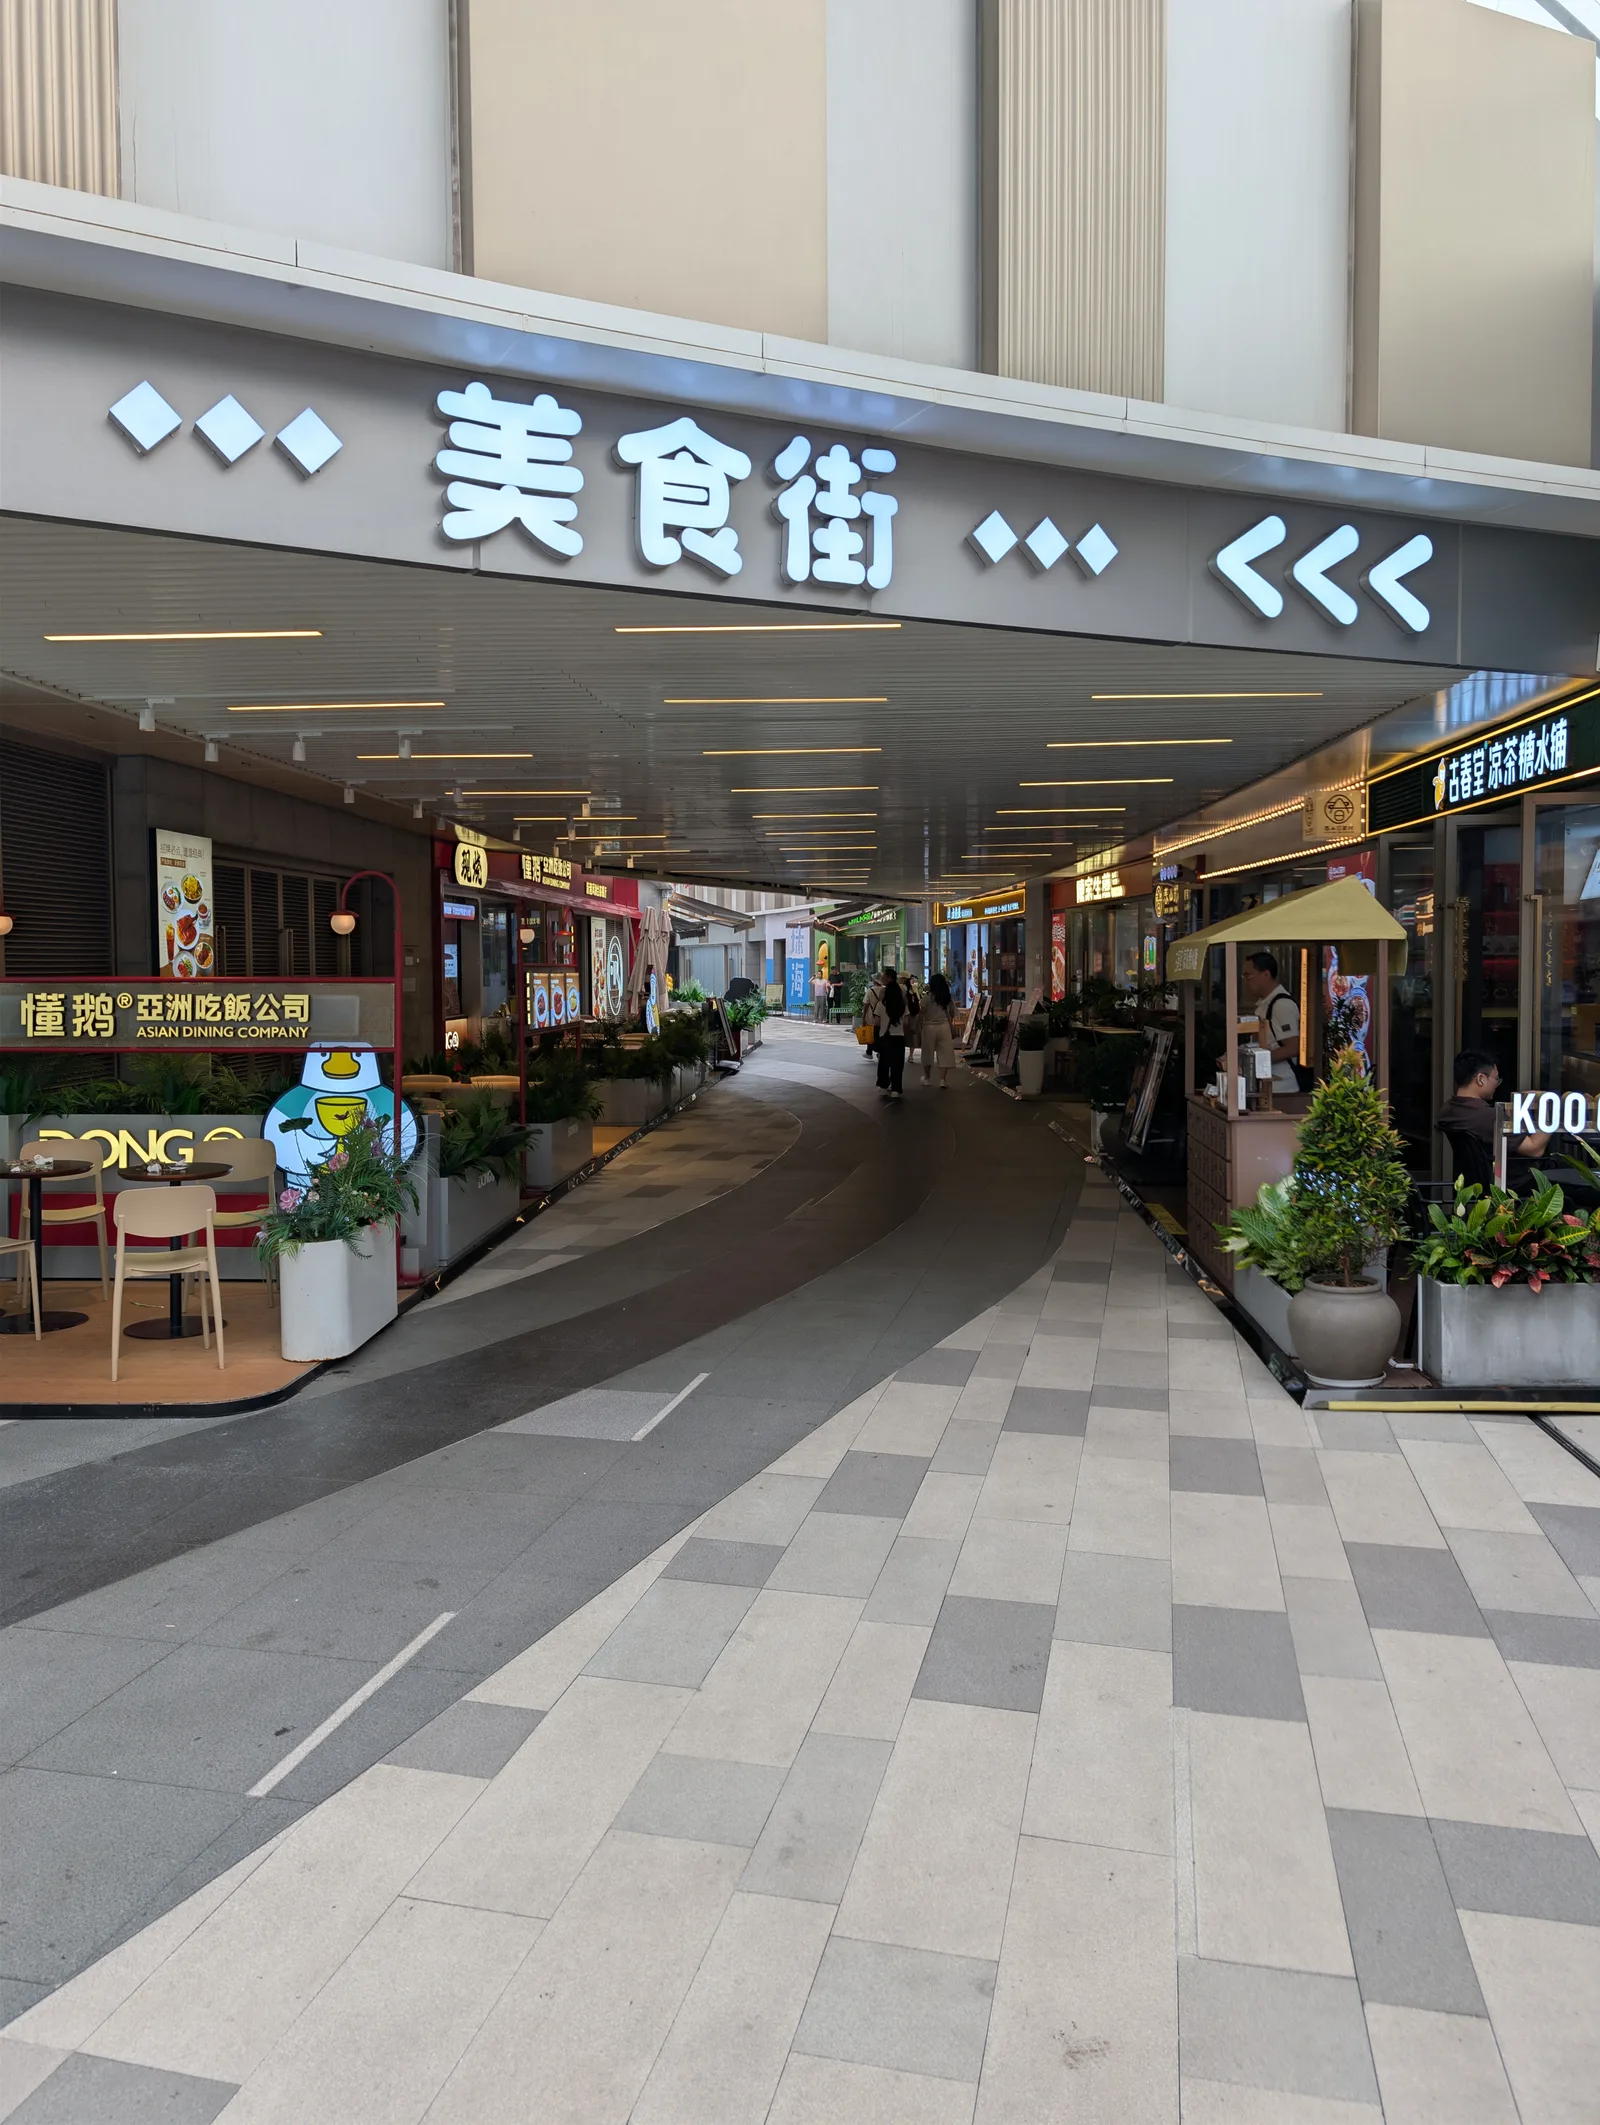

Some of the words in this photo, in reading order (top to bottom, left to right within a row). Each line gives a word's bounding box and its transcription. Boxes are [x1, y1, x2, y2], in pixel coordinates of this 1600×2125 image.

[435, 381, 899, 590] 美食街
[136, 993, 310, 1023] 亞洲吃飯公司
[136, 1026, 180, 1038] ASIAN
[182, 1026, 234, 1038] DINING
[237, 1026, 309, 1038] COMPANY
[1512, 1091, 1587, 1134] KOO
[39, 1128, 194, 1169] ONG
